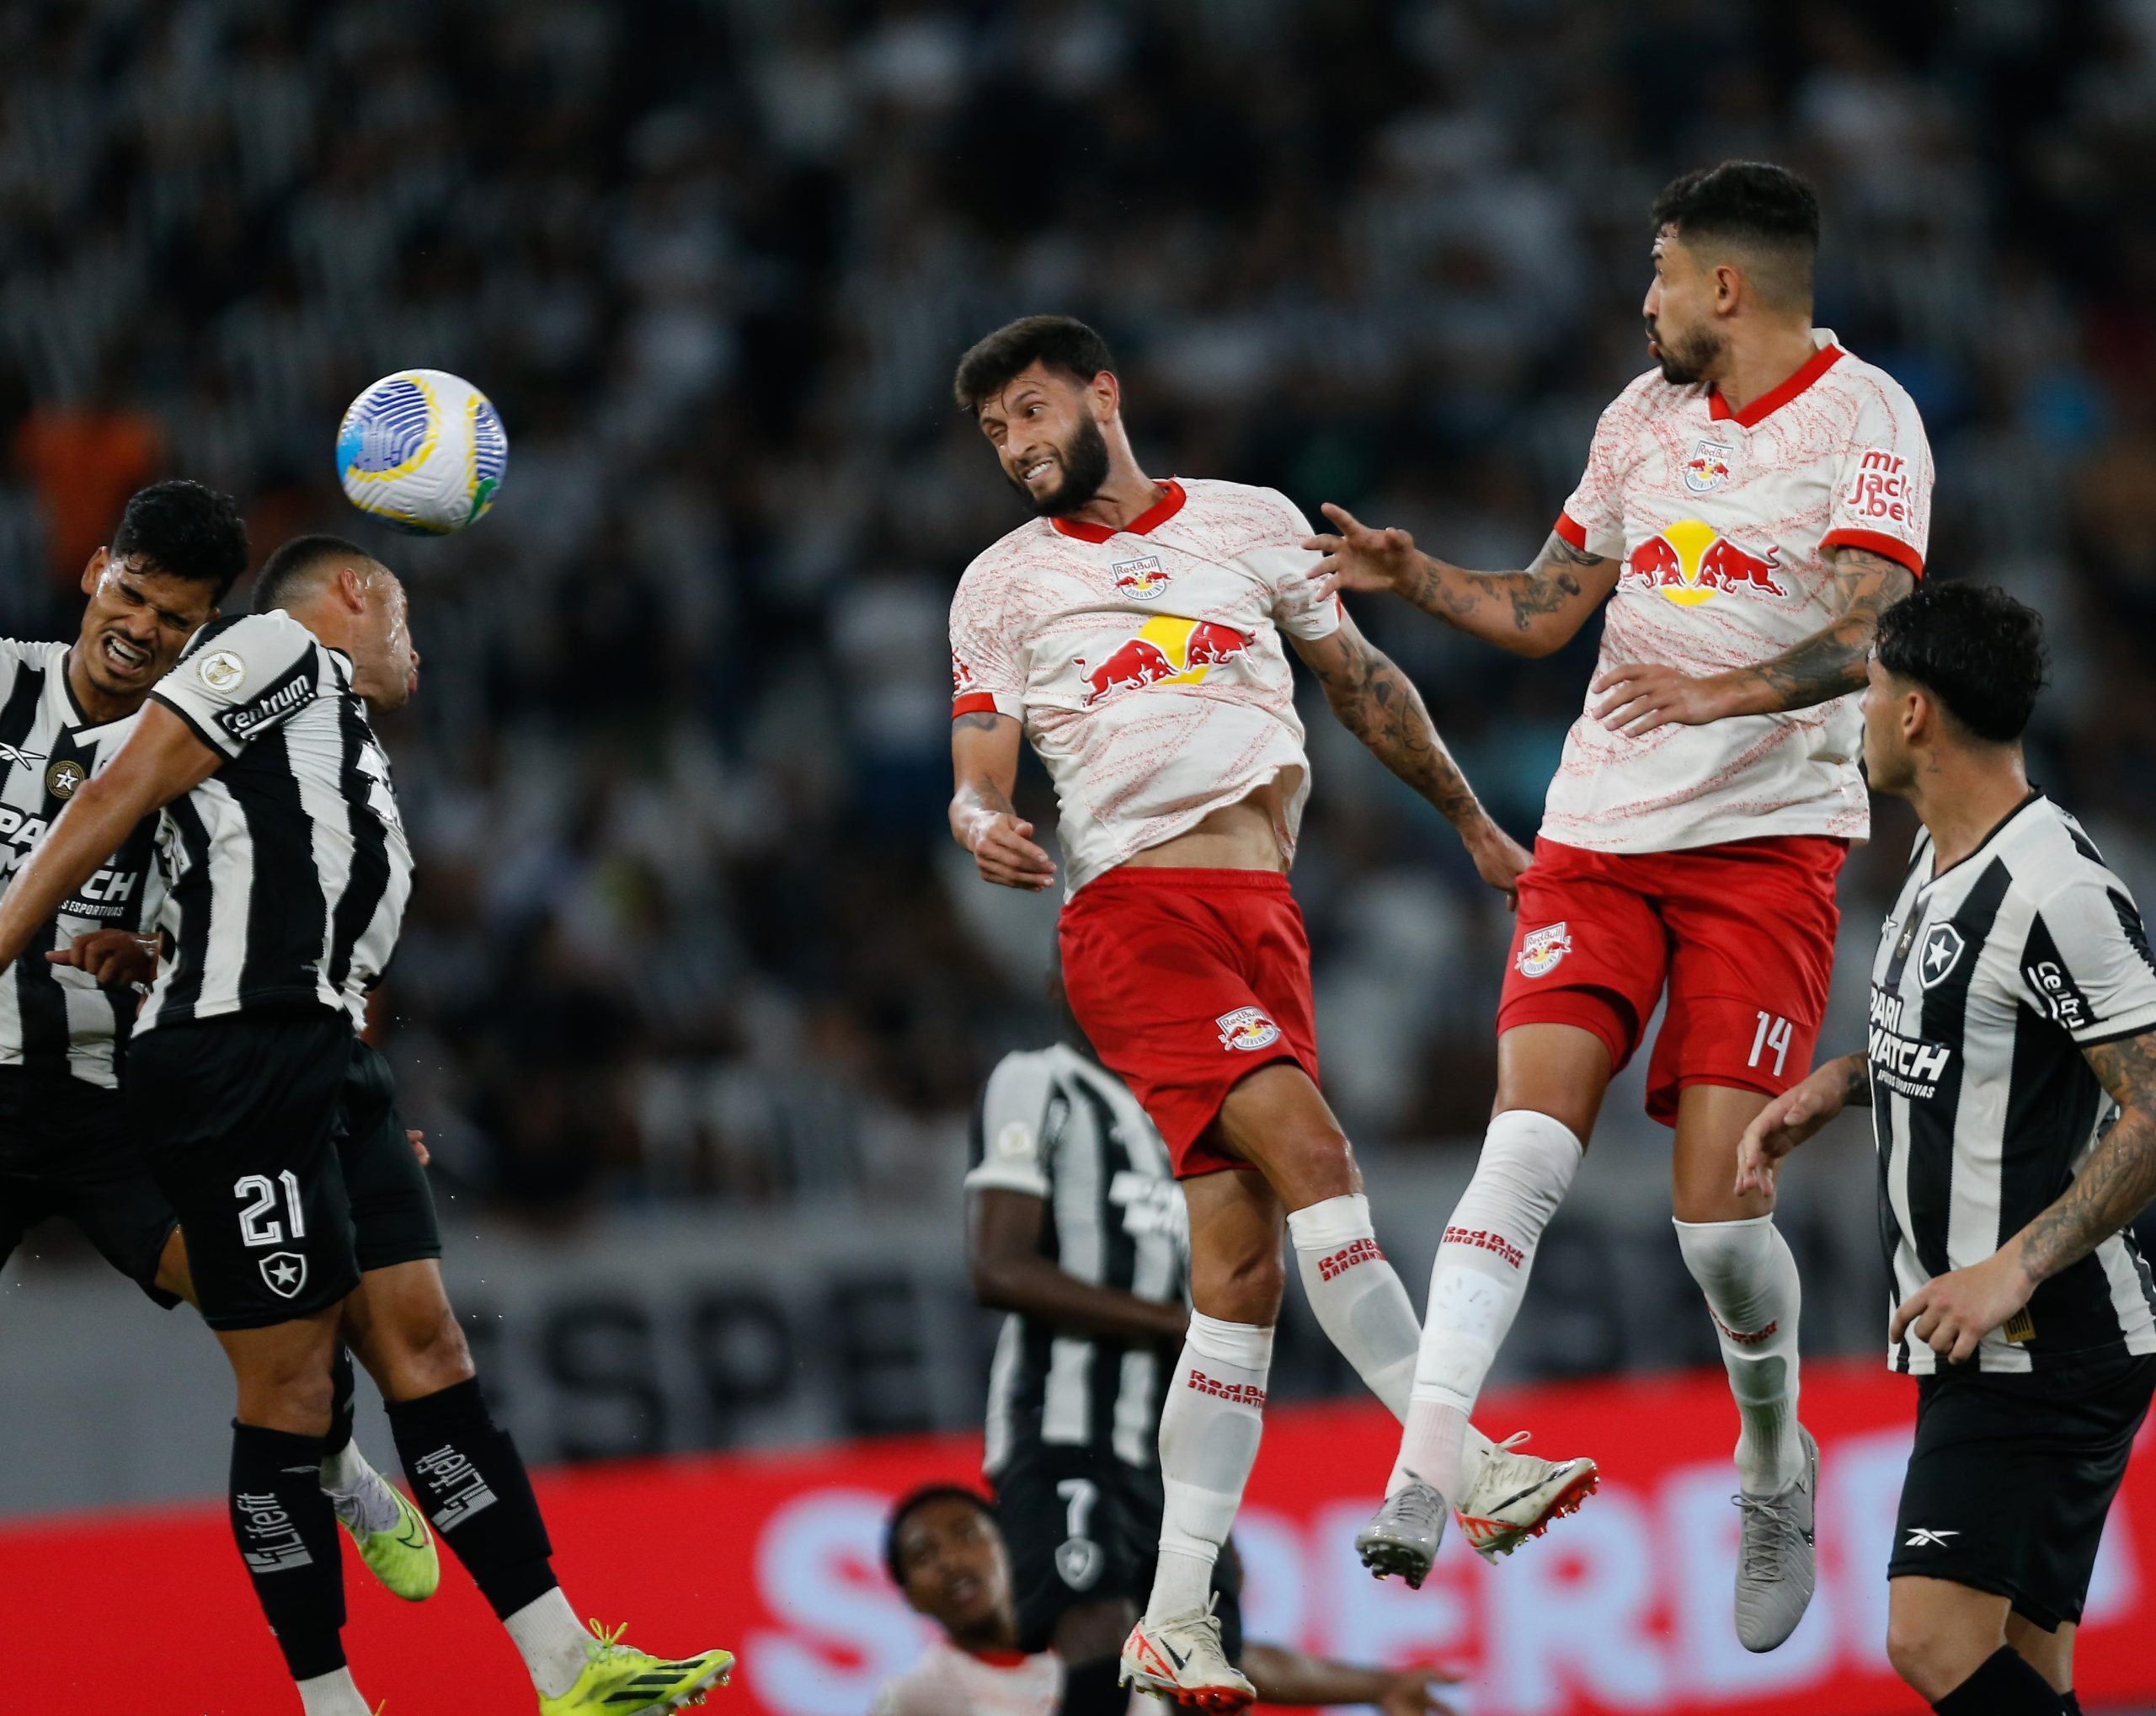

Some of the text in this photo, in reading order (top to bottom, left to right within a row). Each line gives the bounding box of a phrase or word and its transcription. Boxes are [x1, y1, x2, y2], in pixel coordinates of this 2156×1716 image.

[1860, 451, 1904, 473] mr
[221, 675, 310, 733] Centrum
[0, 805, 49, 845] PA
[68, 901, 124, 917] ESPORTIVAS
[2037, 961, 2084, 1028] Centru
[1748, 1010, 1793, 1077] 14
[234, 1169, 305, 1247] 21
[1056, 1478, 1097, 1538] 7
